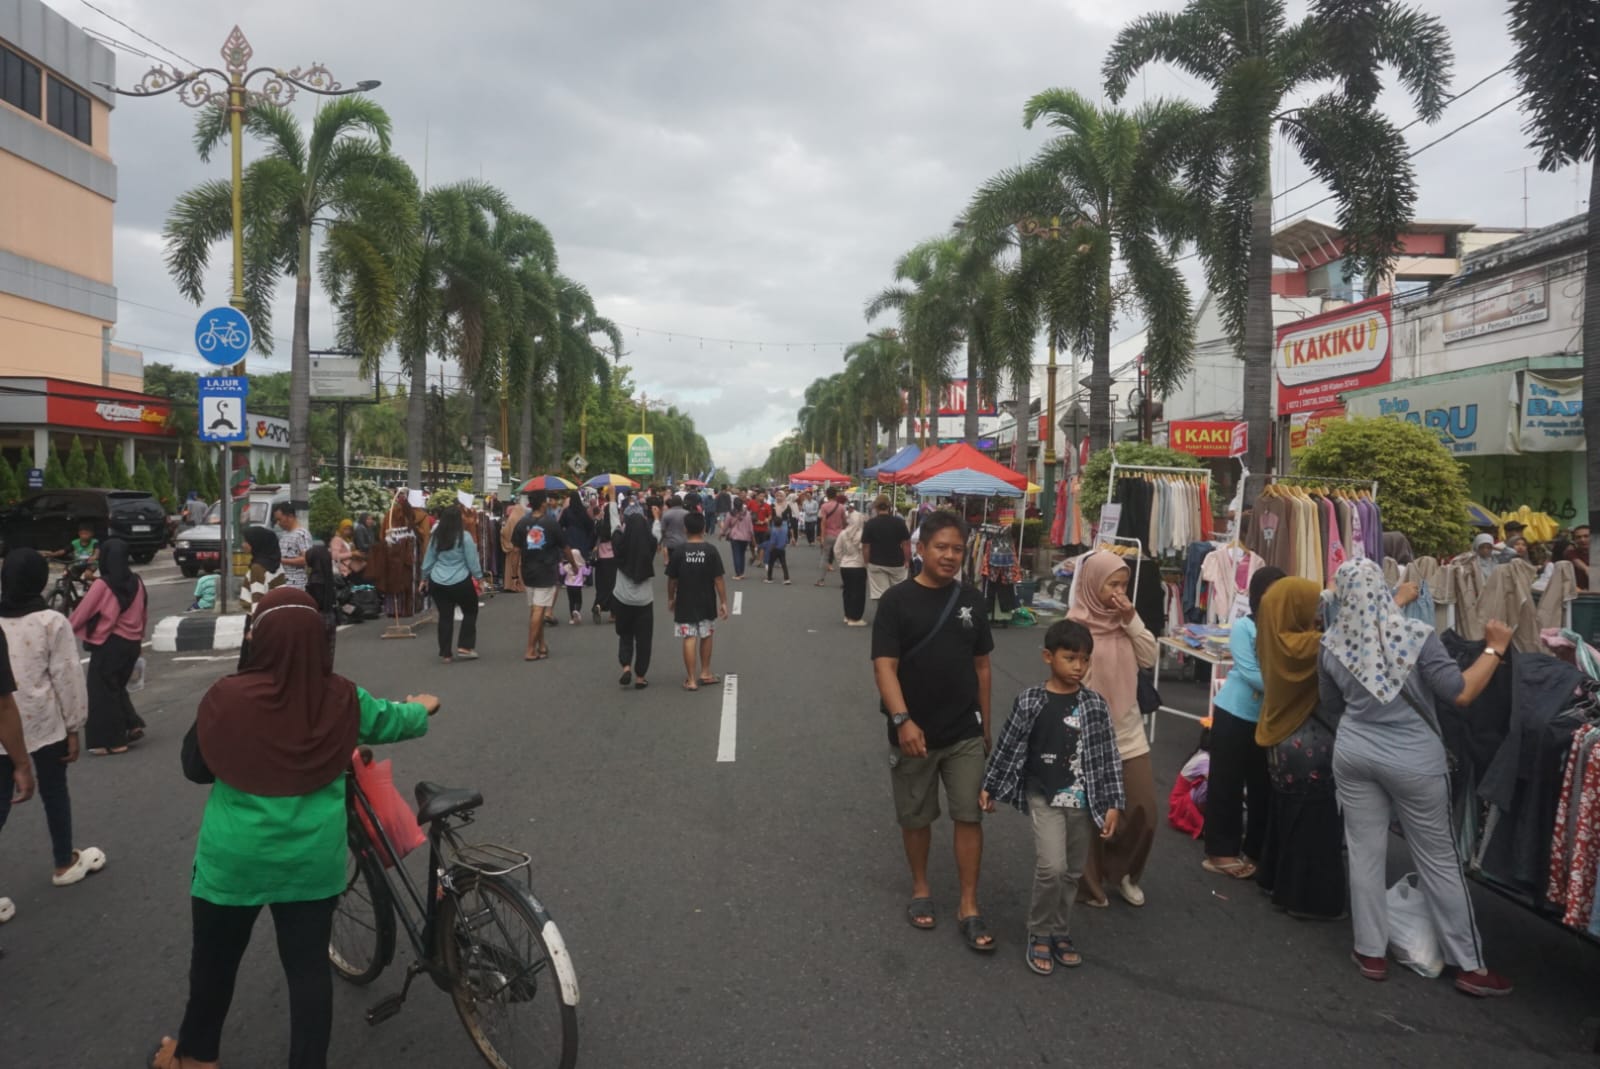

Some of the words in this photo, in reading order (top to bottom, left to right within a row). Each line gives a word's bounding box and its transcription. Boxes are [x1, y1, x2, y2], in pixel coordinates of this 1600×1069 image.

[1293, 323, 1365, 366] KAKIKU
[207, 379, 239, 387] LAJUR
[1185, 428, 1230, 443] KAKI
